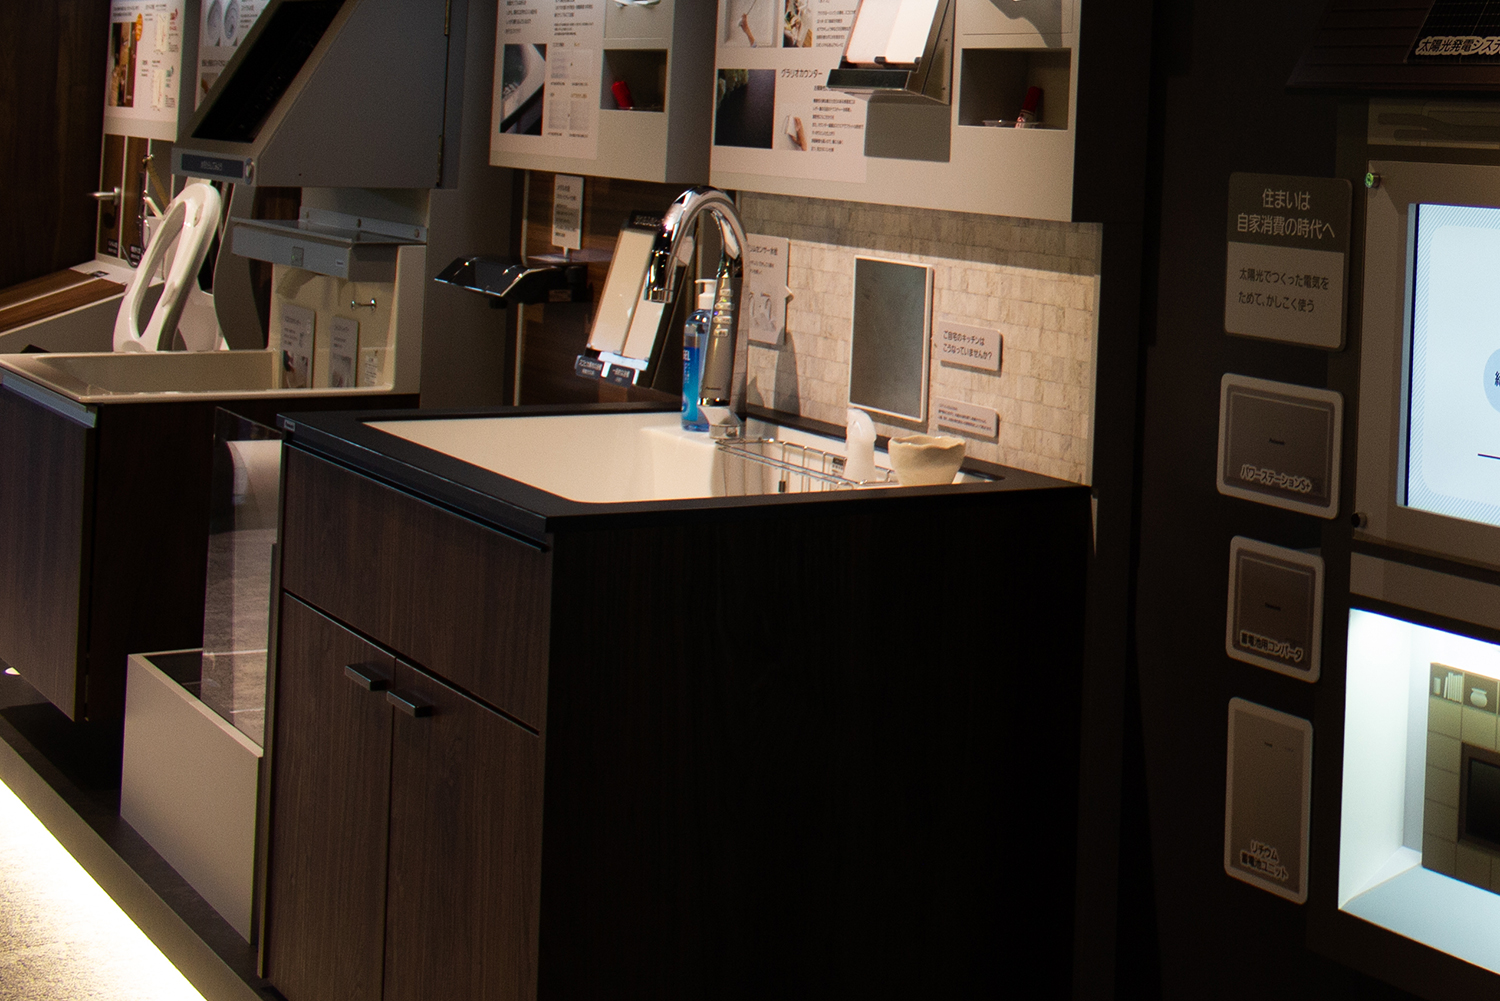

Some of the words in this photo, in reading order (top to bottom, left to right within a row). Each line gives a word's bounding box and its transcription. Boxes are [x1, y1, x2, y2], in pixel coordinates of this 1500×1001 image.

[1262, 188, 1311, 210] 住まいは
[1237, 212, 1336, 239] 自家消費の時代へ
[1239, 267, 1329, 290] 太陽光でつくった電気を
[1238, 291, 1315, 313] ためて、かしこく使う
[943, 330, 985, 346] ご自宅のキッチンは
